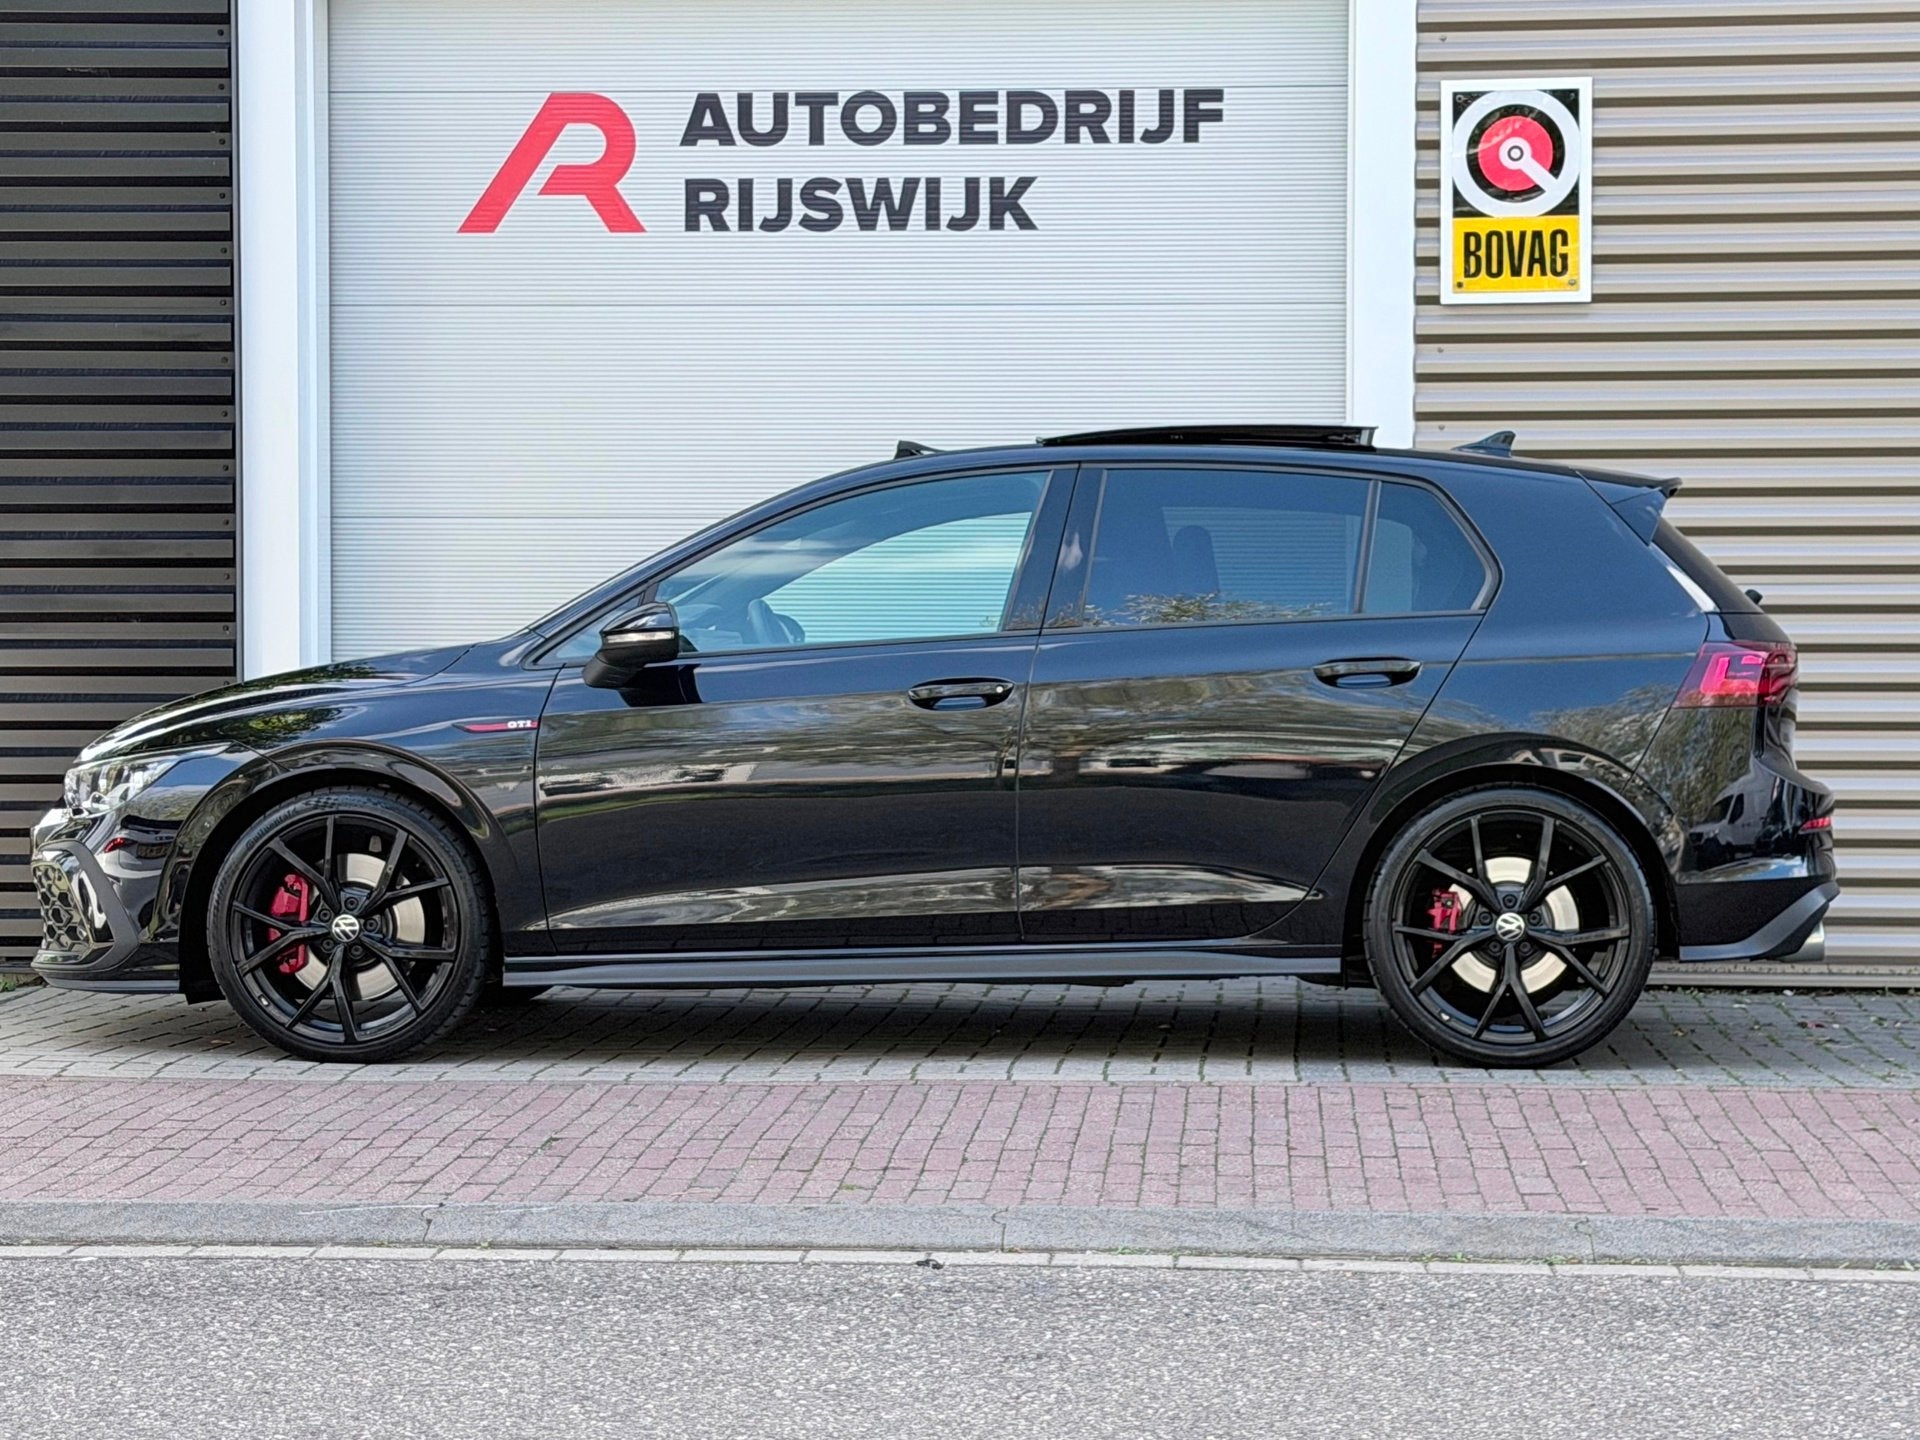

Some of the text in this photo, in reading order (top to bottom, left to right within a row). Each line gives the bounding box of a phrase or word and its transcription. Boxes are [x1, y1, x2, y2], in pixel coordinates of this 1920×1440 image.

[680, 88, 1224, 147] AUTOBEDRIJF
[685, 176, 1038, 232] RIJSWIJK
[1463, 228, 1569, 279] BOVAG
[507, 720, 532, 729] GTI
